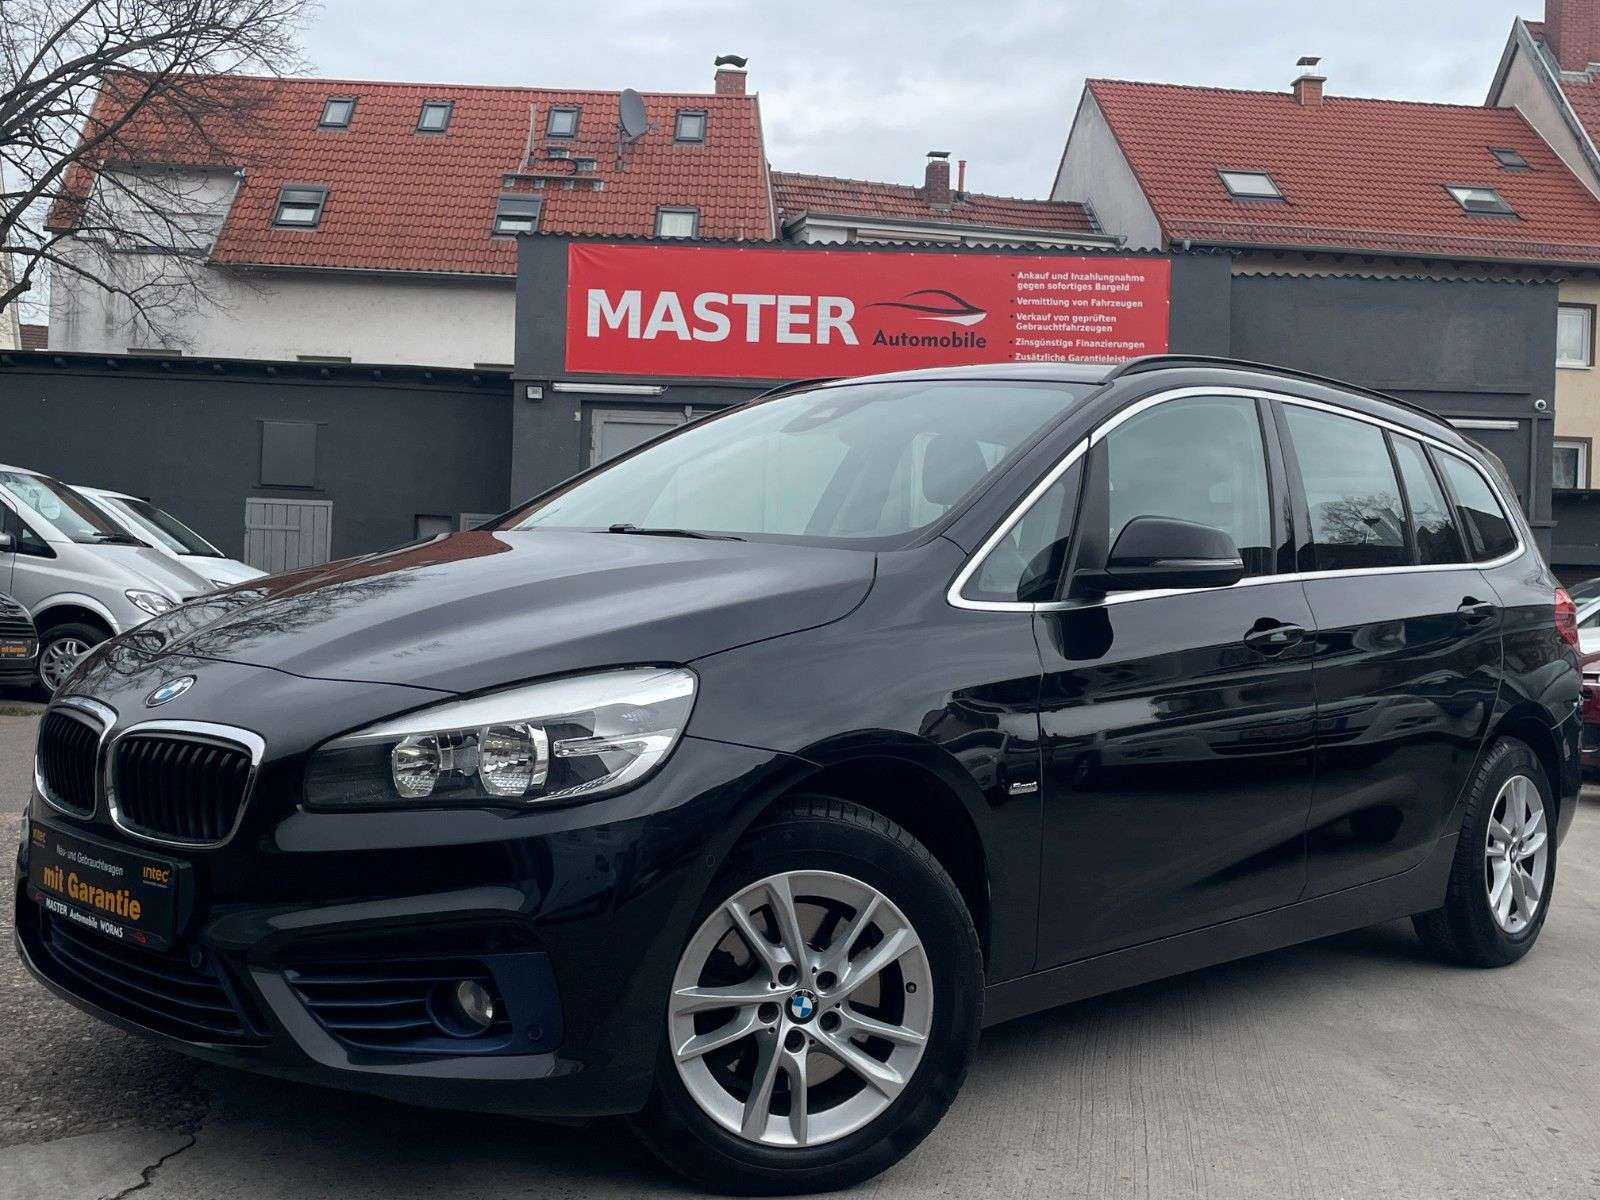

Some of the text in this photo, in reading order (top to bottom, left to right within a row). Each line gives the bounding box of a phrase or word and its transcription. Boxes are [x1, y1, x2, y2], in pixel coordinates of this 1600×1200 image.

[1017, 271, 1145, 283] Ankauf und Inzahlungnahme
[1017, 282, 1130, 292] gegen sofortiges Bargeld
[1016, 297, 1070, 307] Vermittlung
[1091, 299, 1143, 309] Fahrzeugen
[586, 288, 860, 345] MASTER
[1016, 313, 1051, 321] Verkauf
[1072, 314, 1117, 324] geprüften
[1015, 322, 1113, 333] Gebrauchtfahrzeugen
[872, 330, 987, 349] Automobile
[1015, 338, 1145, 349] Zinsgünstige Finanzierungen
[43, 865, 141, 920] mit Garantie
[45, 898, 124, 938] MASTER Automobile WORMS
